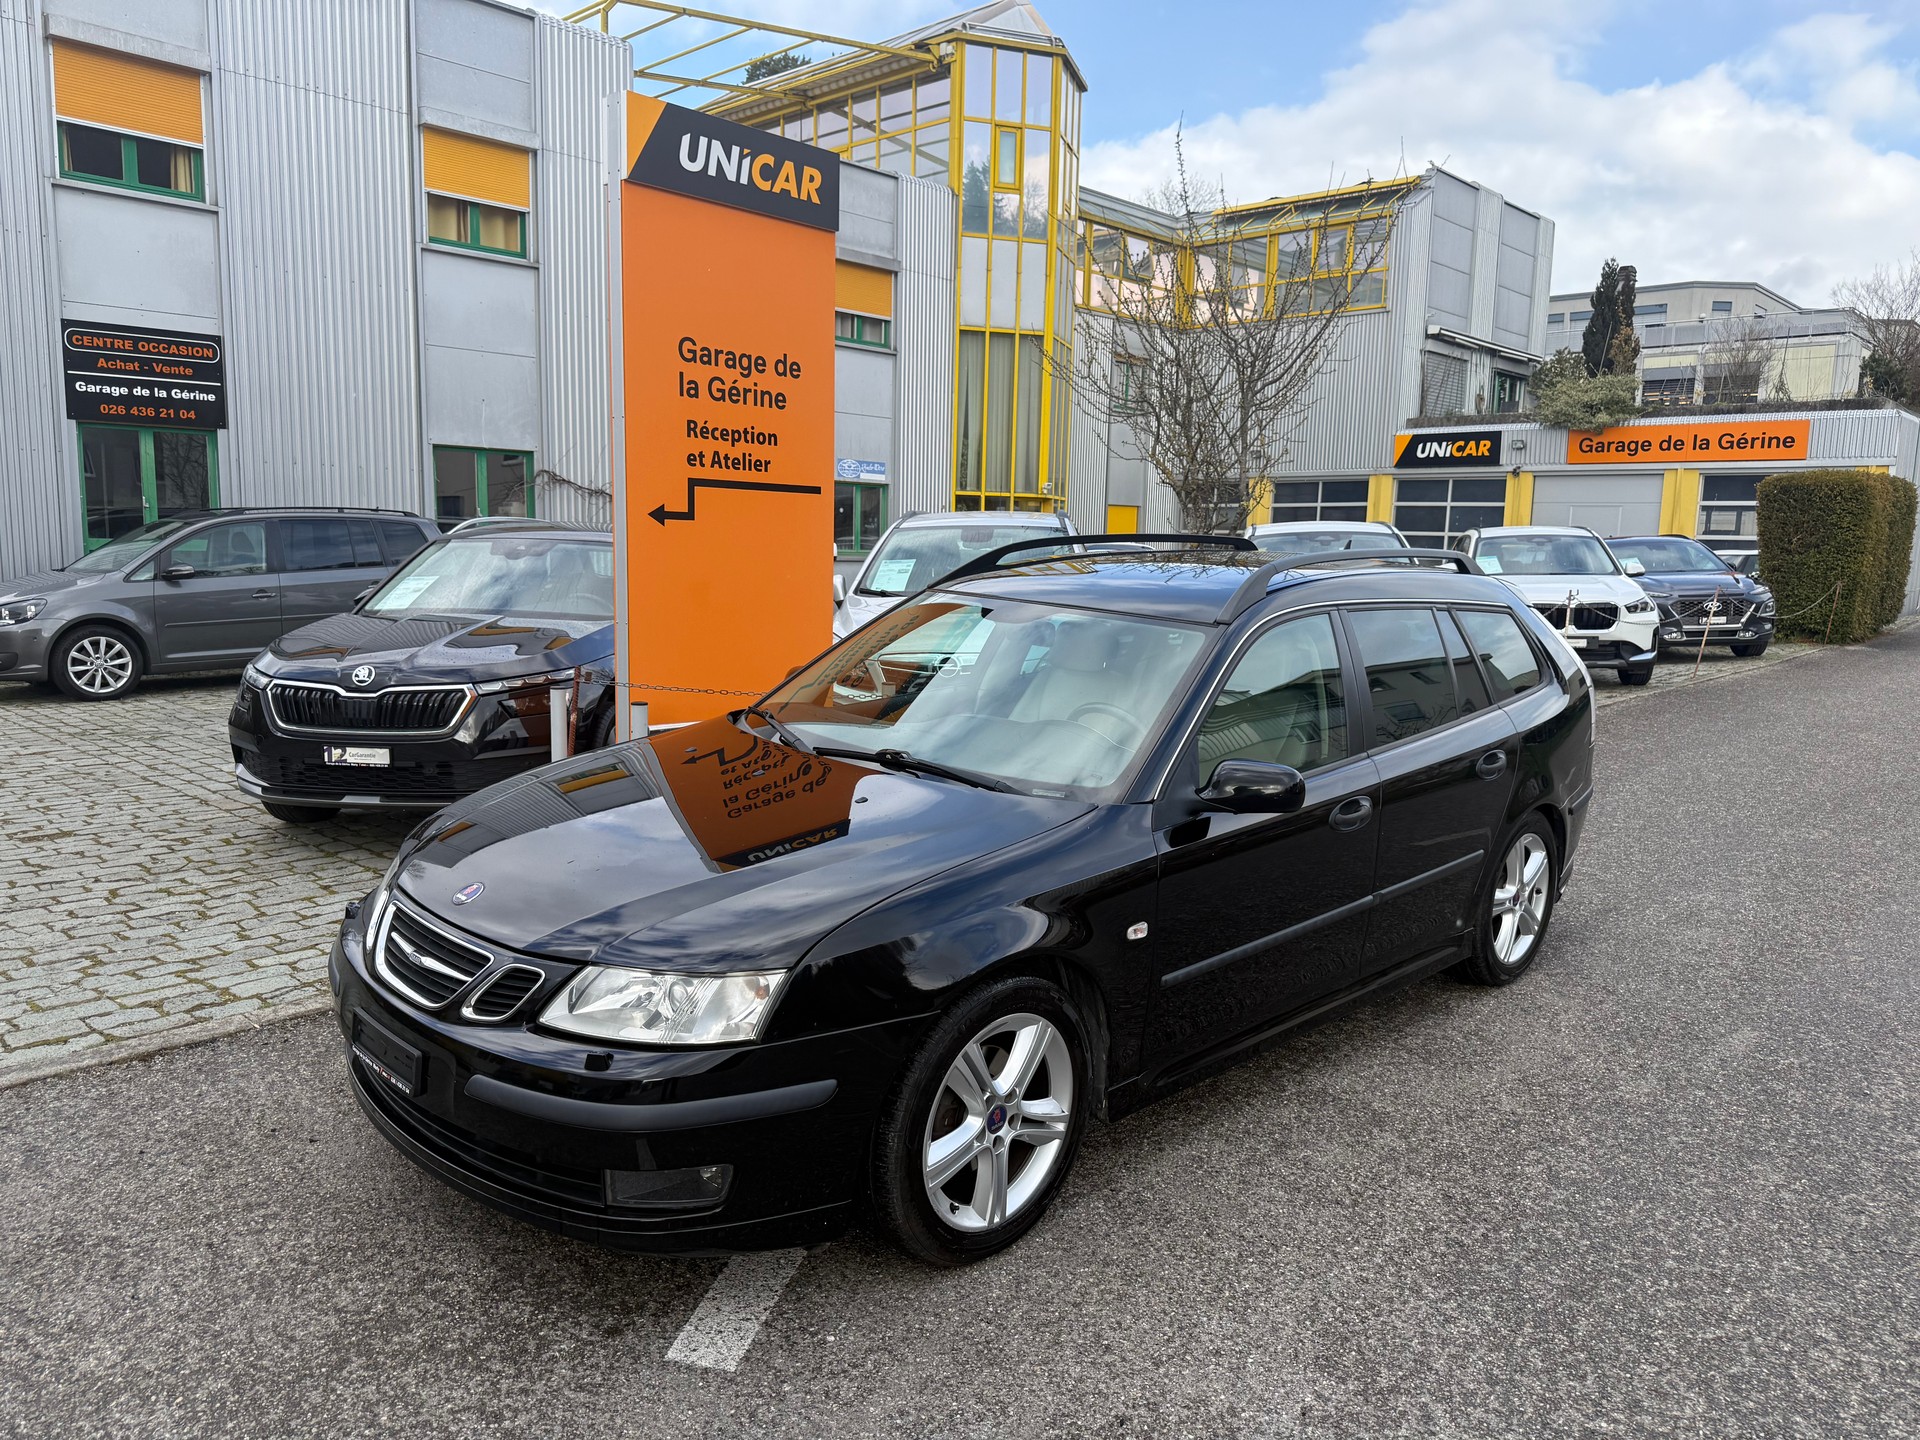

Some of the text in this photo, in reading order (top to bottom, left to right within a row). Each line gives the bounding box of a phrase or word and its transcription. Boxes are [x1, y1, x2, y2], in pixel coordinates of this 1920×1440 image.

[72, 335, 213, 358] CENTRE OCCASION
[678, 336, 802, 379] Garage de
[97, 357, 140, 371] Achat
[152, 362, 193, 376] Vente
[75, 381, 216, 402] Garage de la Gérine
[679, 371, 787, 410] la Gérine
[100, 404, 196, 420] 026 436 21 04
[687, 419, 778, 447] Réception
[1578, 431, 1796, 456] Garage de la Gérine
[687, 450, 771, 472] et Atelier
